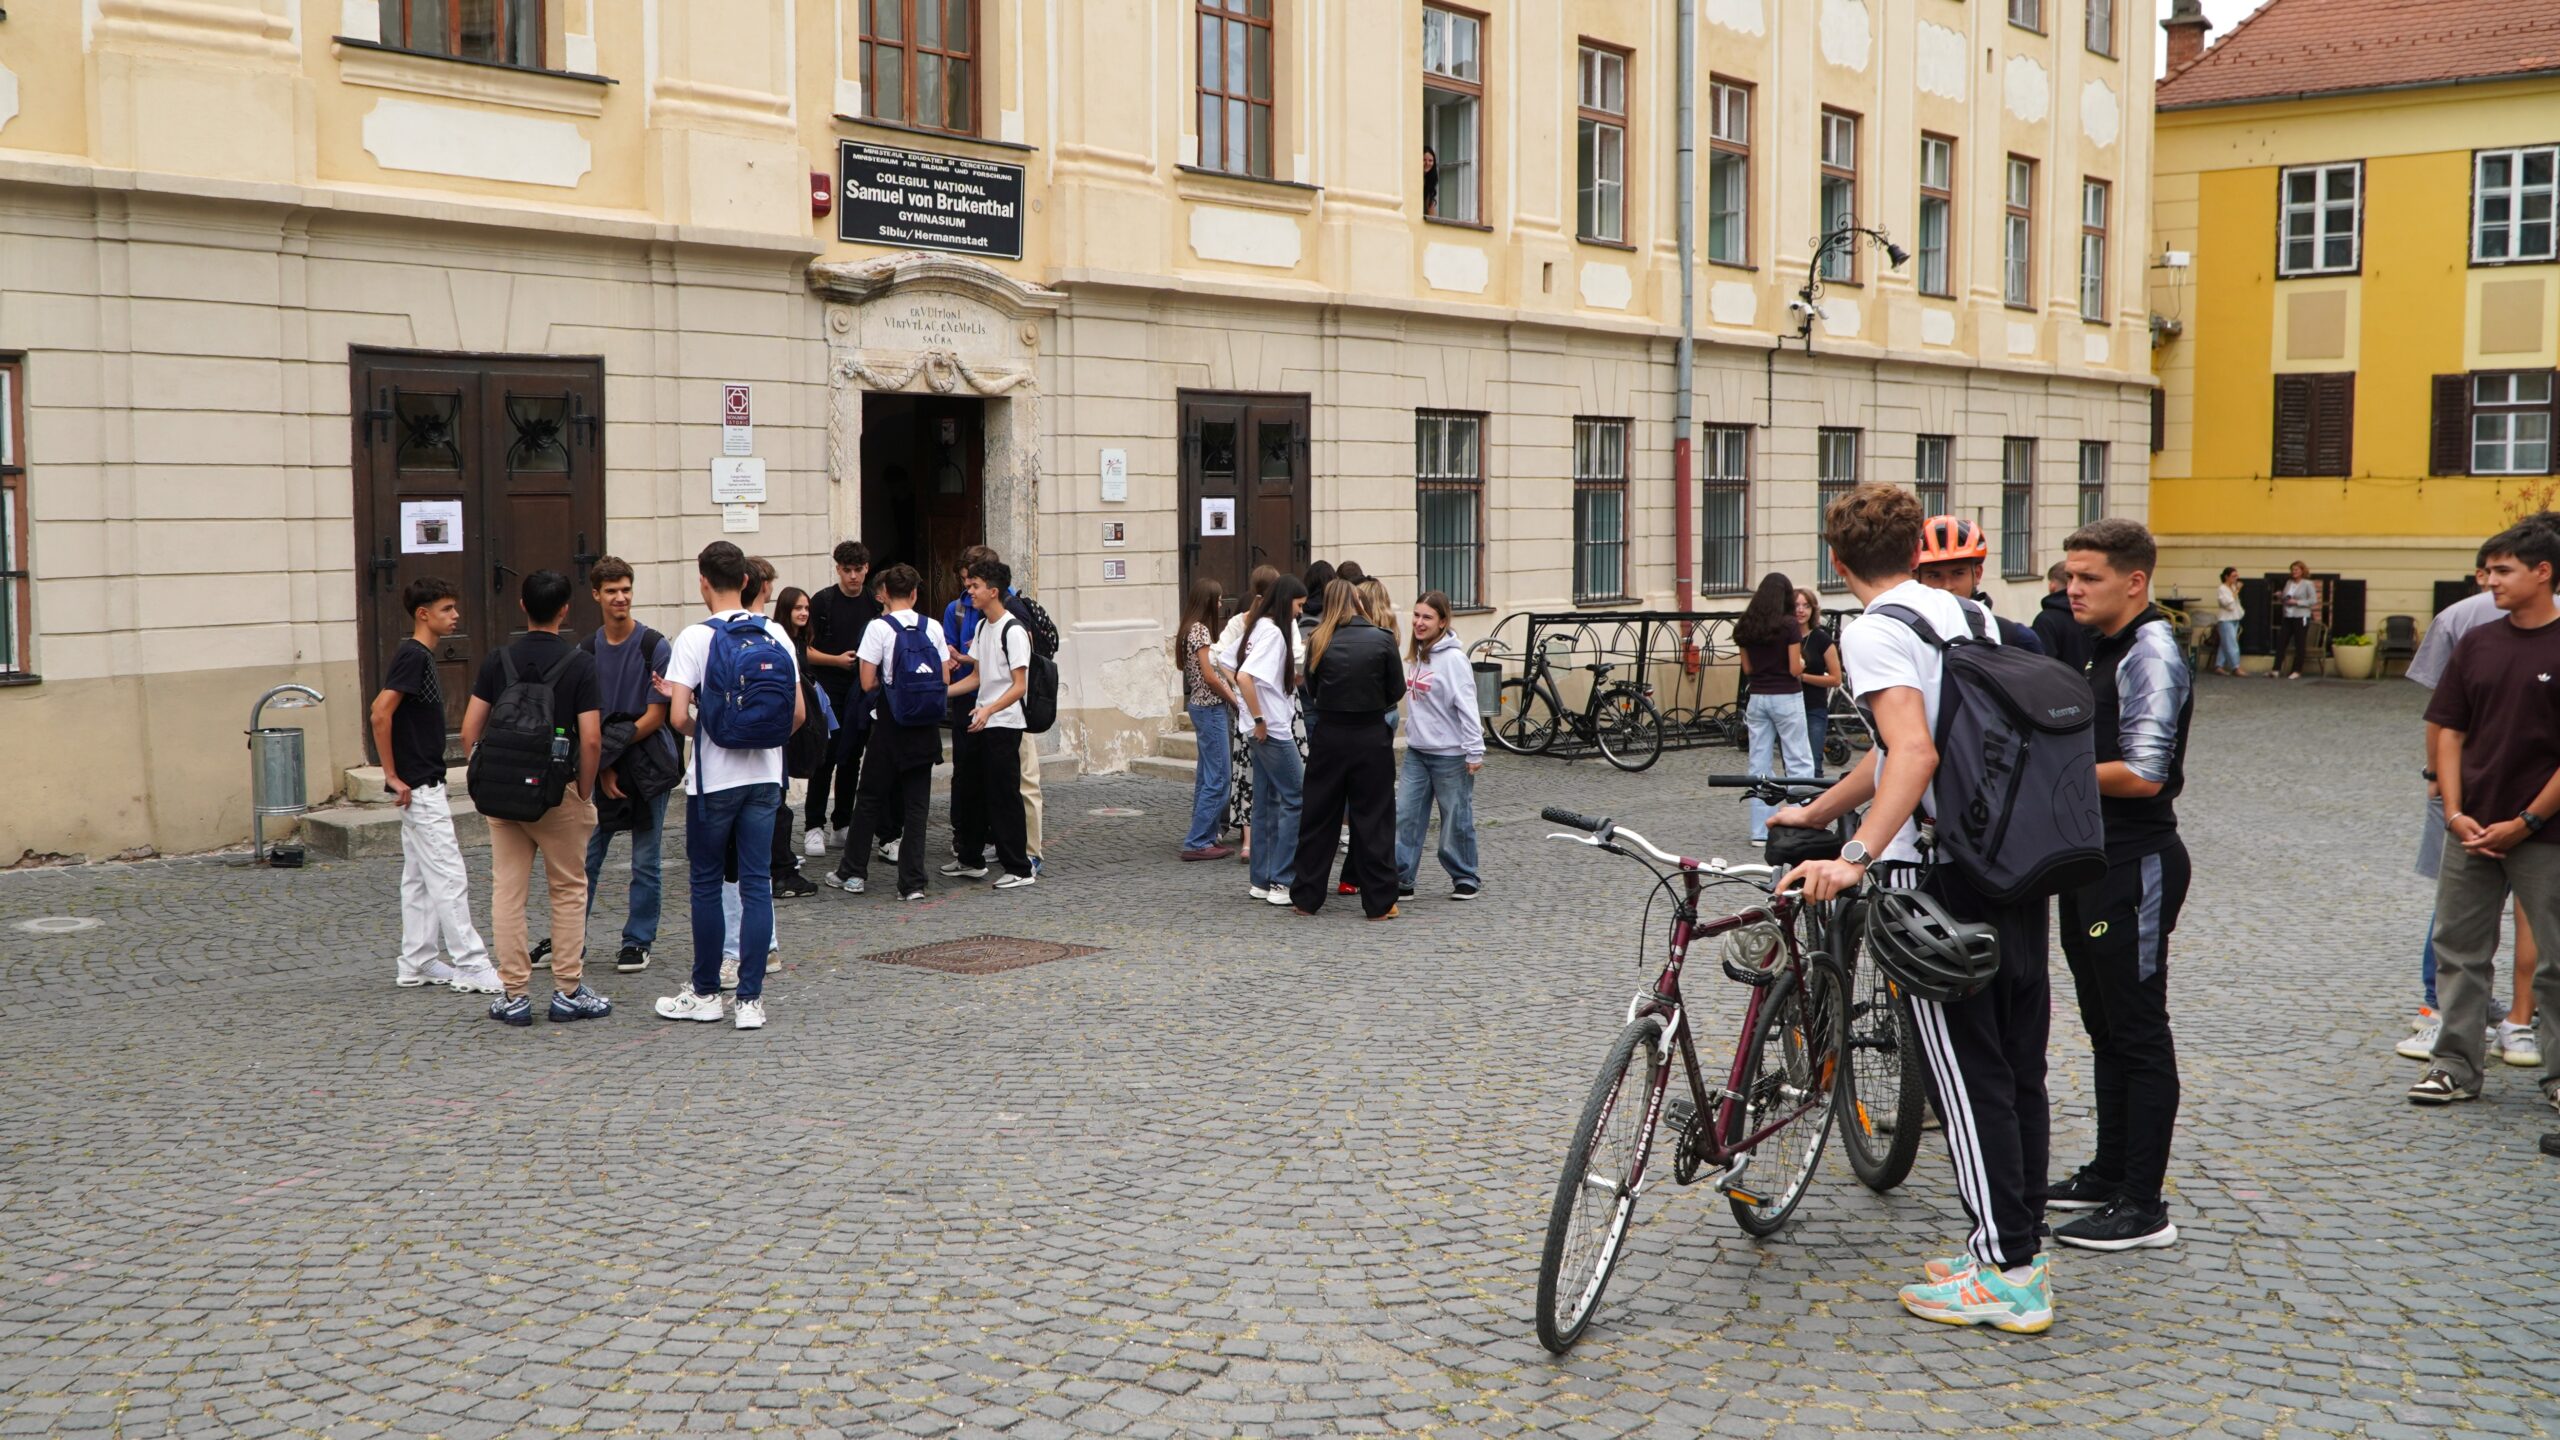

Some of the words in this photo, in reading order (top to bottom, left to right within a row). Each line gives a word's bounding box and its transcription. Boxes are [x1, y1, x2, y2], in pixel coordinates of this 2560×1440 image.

[852, 153, 899, 165] MINISTERIUM
[921, 163, 950, 173] BILDUNG
[972, 170, 1012, 181] FORSCHUNG
[876, 172, 930, 189] COLEGIUL
[845, 179, 904, 205] Samuel
[907, 192, 933, 209] von
[936, 193, 1014, 218] Brukenthal
[898, 210, 966, 229] GYMNASIUM
[2047, 705, 2081, 719] Kempa
[1636, 1086, 1662, 1160] corratec
